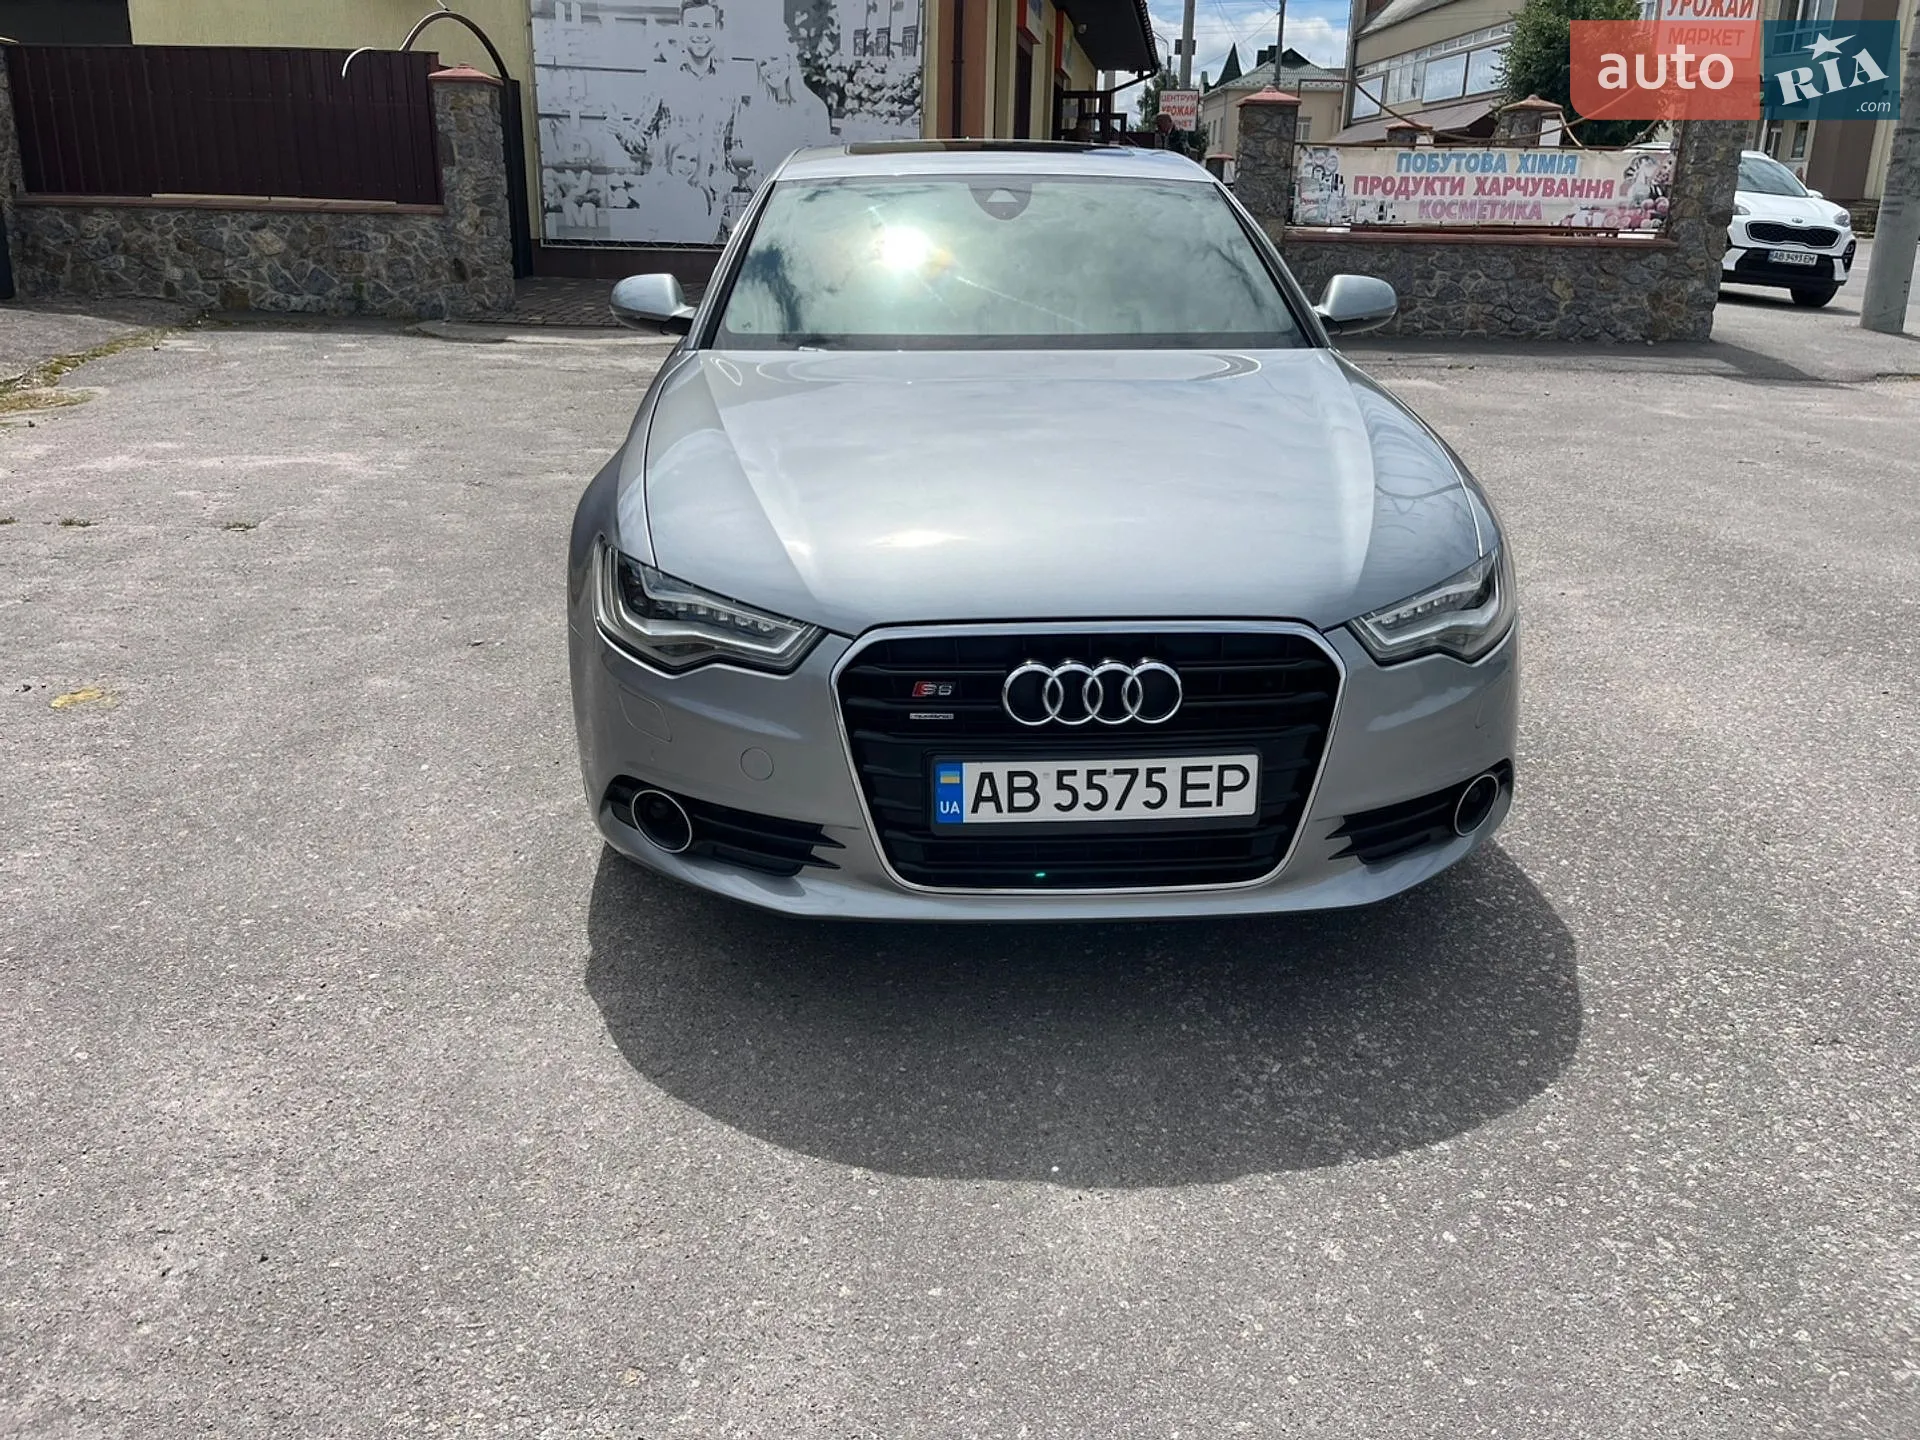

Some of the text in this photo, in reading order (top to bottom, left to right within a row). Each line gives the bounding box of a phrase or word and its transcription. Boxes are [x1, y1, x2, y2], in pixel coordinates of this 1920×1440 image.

[1667, 27, 1745, 46] МАРКЕТ
[1396, 152, 1579, 175] ПОБУТОВА ХІМІЯ
[1353, 175, 1616, 200] ПРОДУКТИ ХАРЧУВАННЯ
[1418, 199, 1543, 220] КОСМЕТИКА
[940, 763, 1250, 814] UA AB 5575 EP
